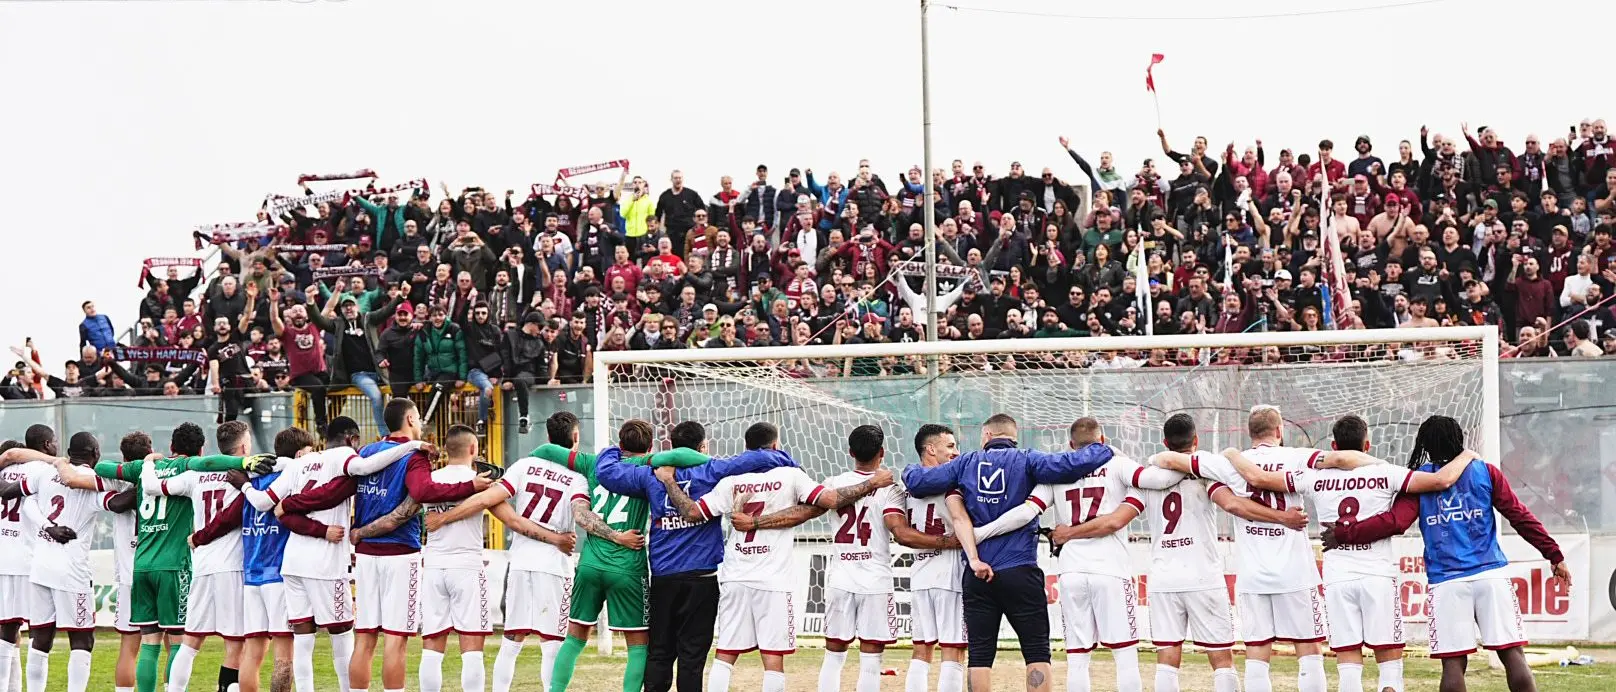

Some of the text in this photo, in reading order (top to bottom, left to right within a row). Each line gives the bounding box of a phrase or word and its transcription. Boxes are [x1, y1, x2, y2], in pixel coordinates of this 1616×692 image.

[156, 350, 176, 360] HAM
[178, 350, 205, 364] UNITE
[527, 466, 573, 486] DE FELICE
[734, 481, 782, 495] PORCINO
[1313, 476, 1389, 492] GIULIODORI
[522, 482, 564, 524] 77
[1065, 486, 1105, 526] 17
[1162, 491, 1182, 534] 9
[1338, 496, 1360, 526] 8
[1426, 509, 1483, 526] GIVOVA
[743, 501, 765, 543] 7
[834, 504, 872, 546] 24
